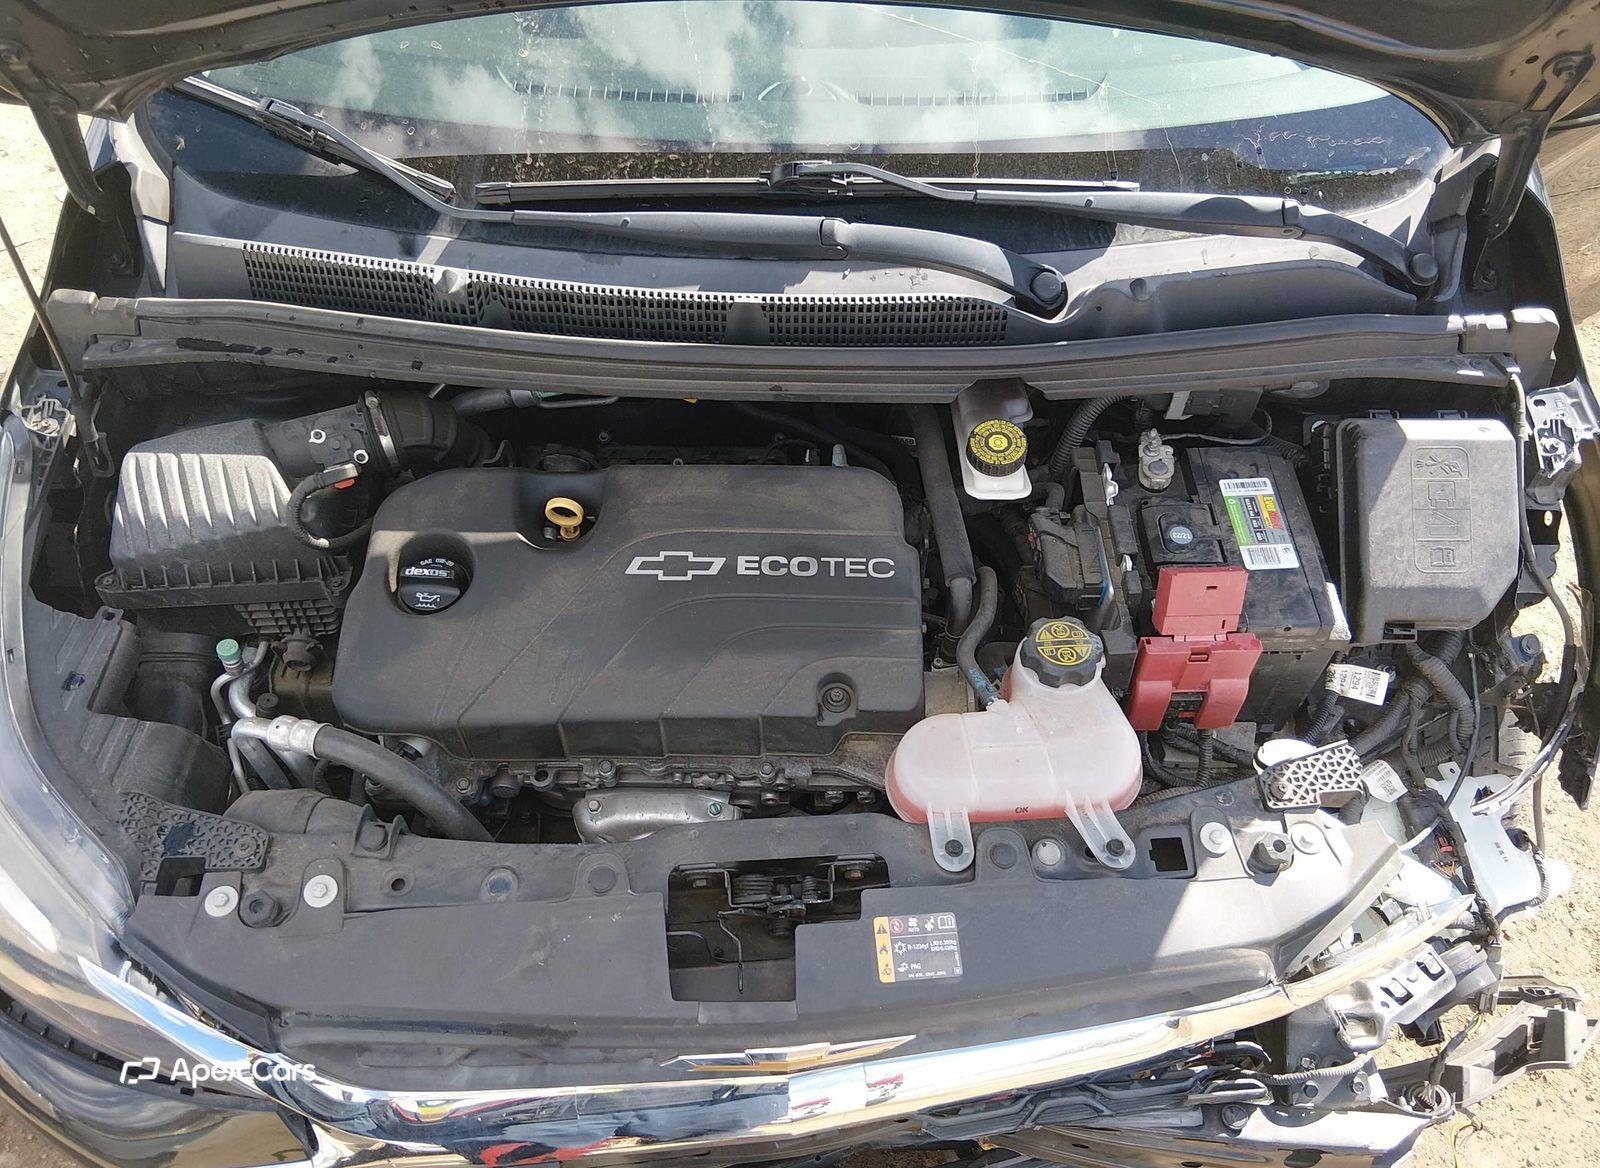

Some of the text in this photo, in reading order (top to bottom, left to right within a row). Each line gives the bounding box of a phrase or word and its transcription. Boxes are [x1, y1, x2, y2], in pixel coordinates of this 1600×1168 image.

[405, 566, 450, 577] dexos
[736, 555, 896, 579] ECOTEC
[1351, 671, 1362, 690] 1294
[1015, 806, 1029, 814] OK
[910, 962, 922, 970] PAG
